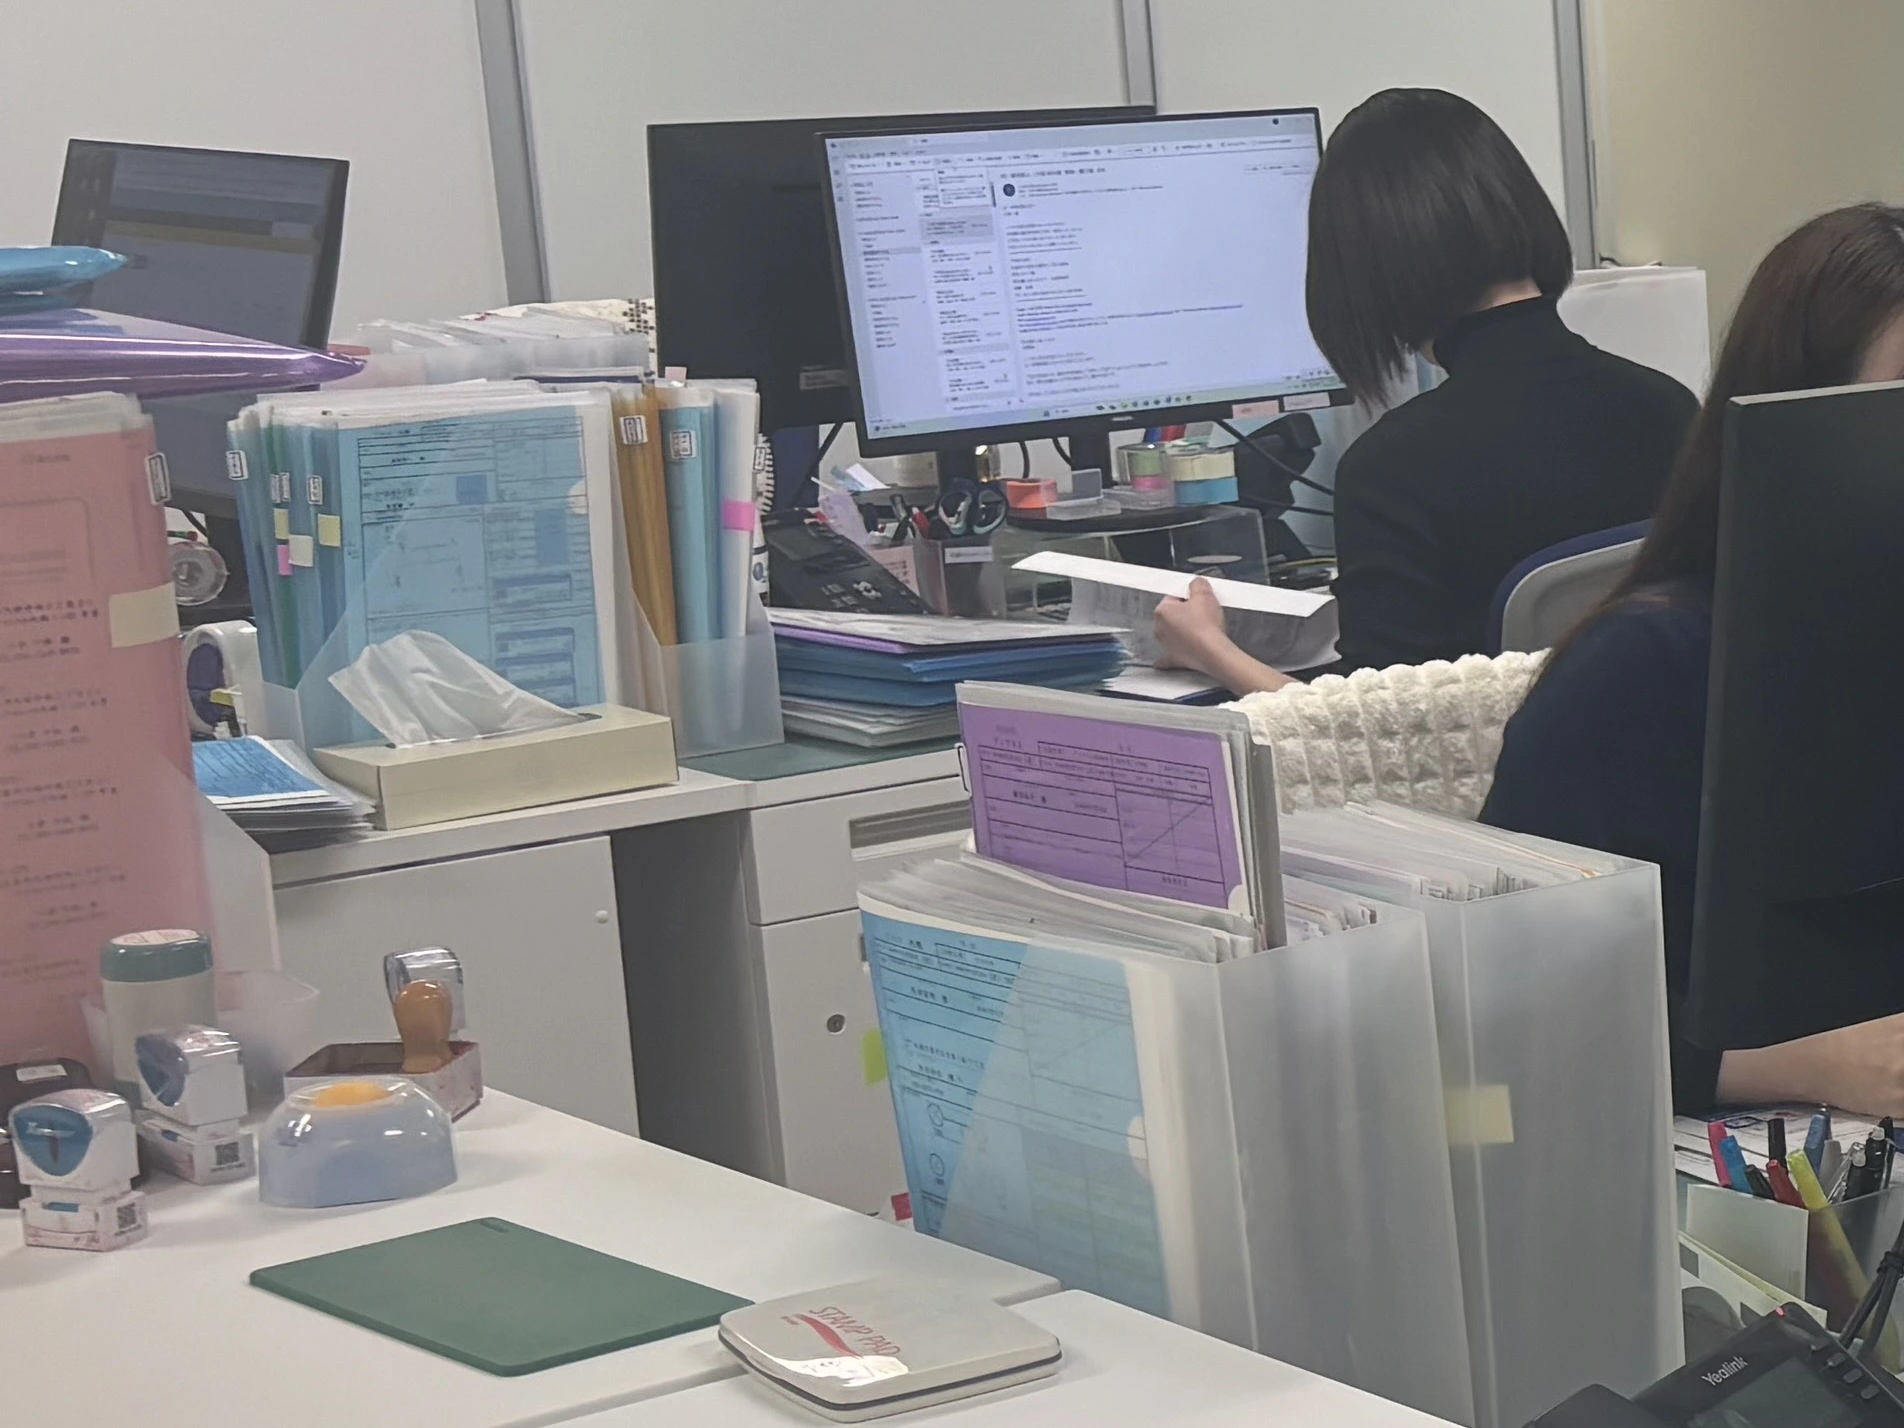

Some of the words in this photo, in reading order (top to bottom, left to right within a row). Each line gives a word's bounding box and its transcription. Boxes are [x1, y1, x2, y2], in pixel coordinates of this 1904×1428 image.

[808, 1306, 873, 1339] STAMP
[860, 1334, 901, 1357] PAD
[1701, 1354, 1749, 1387] Yealink
